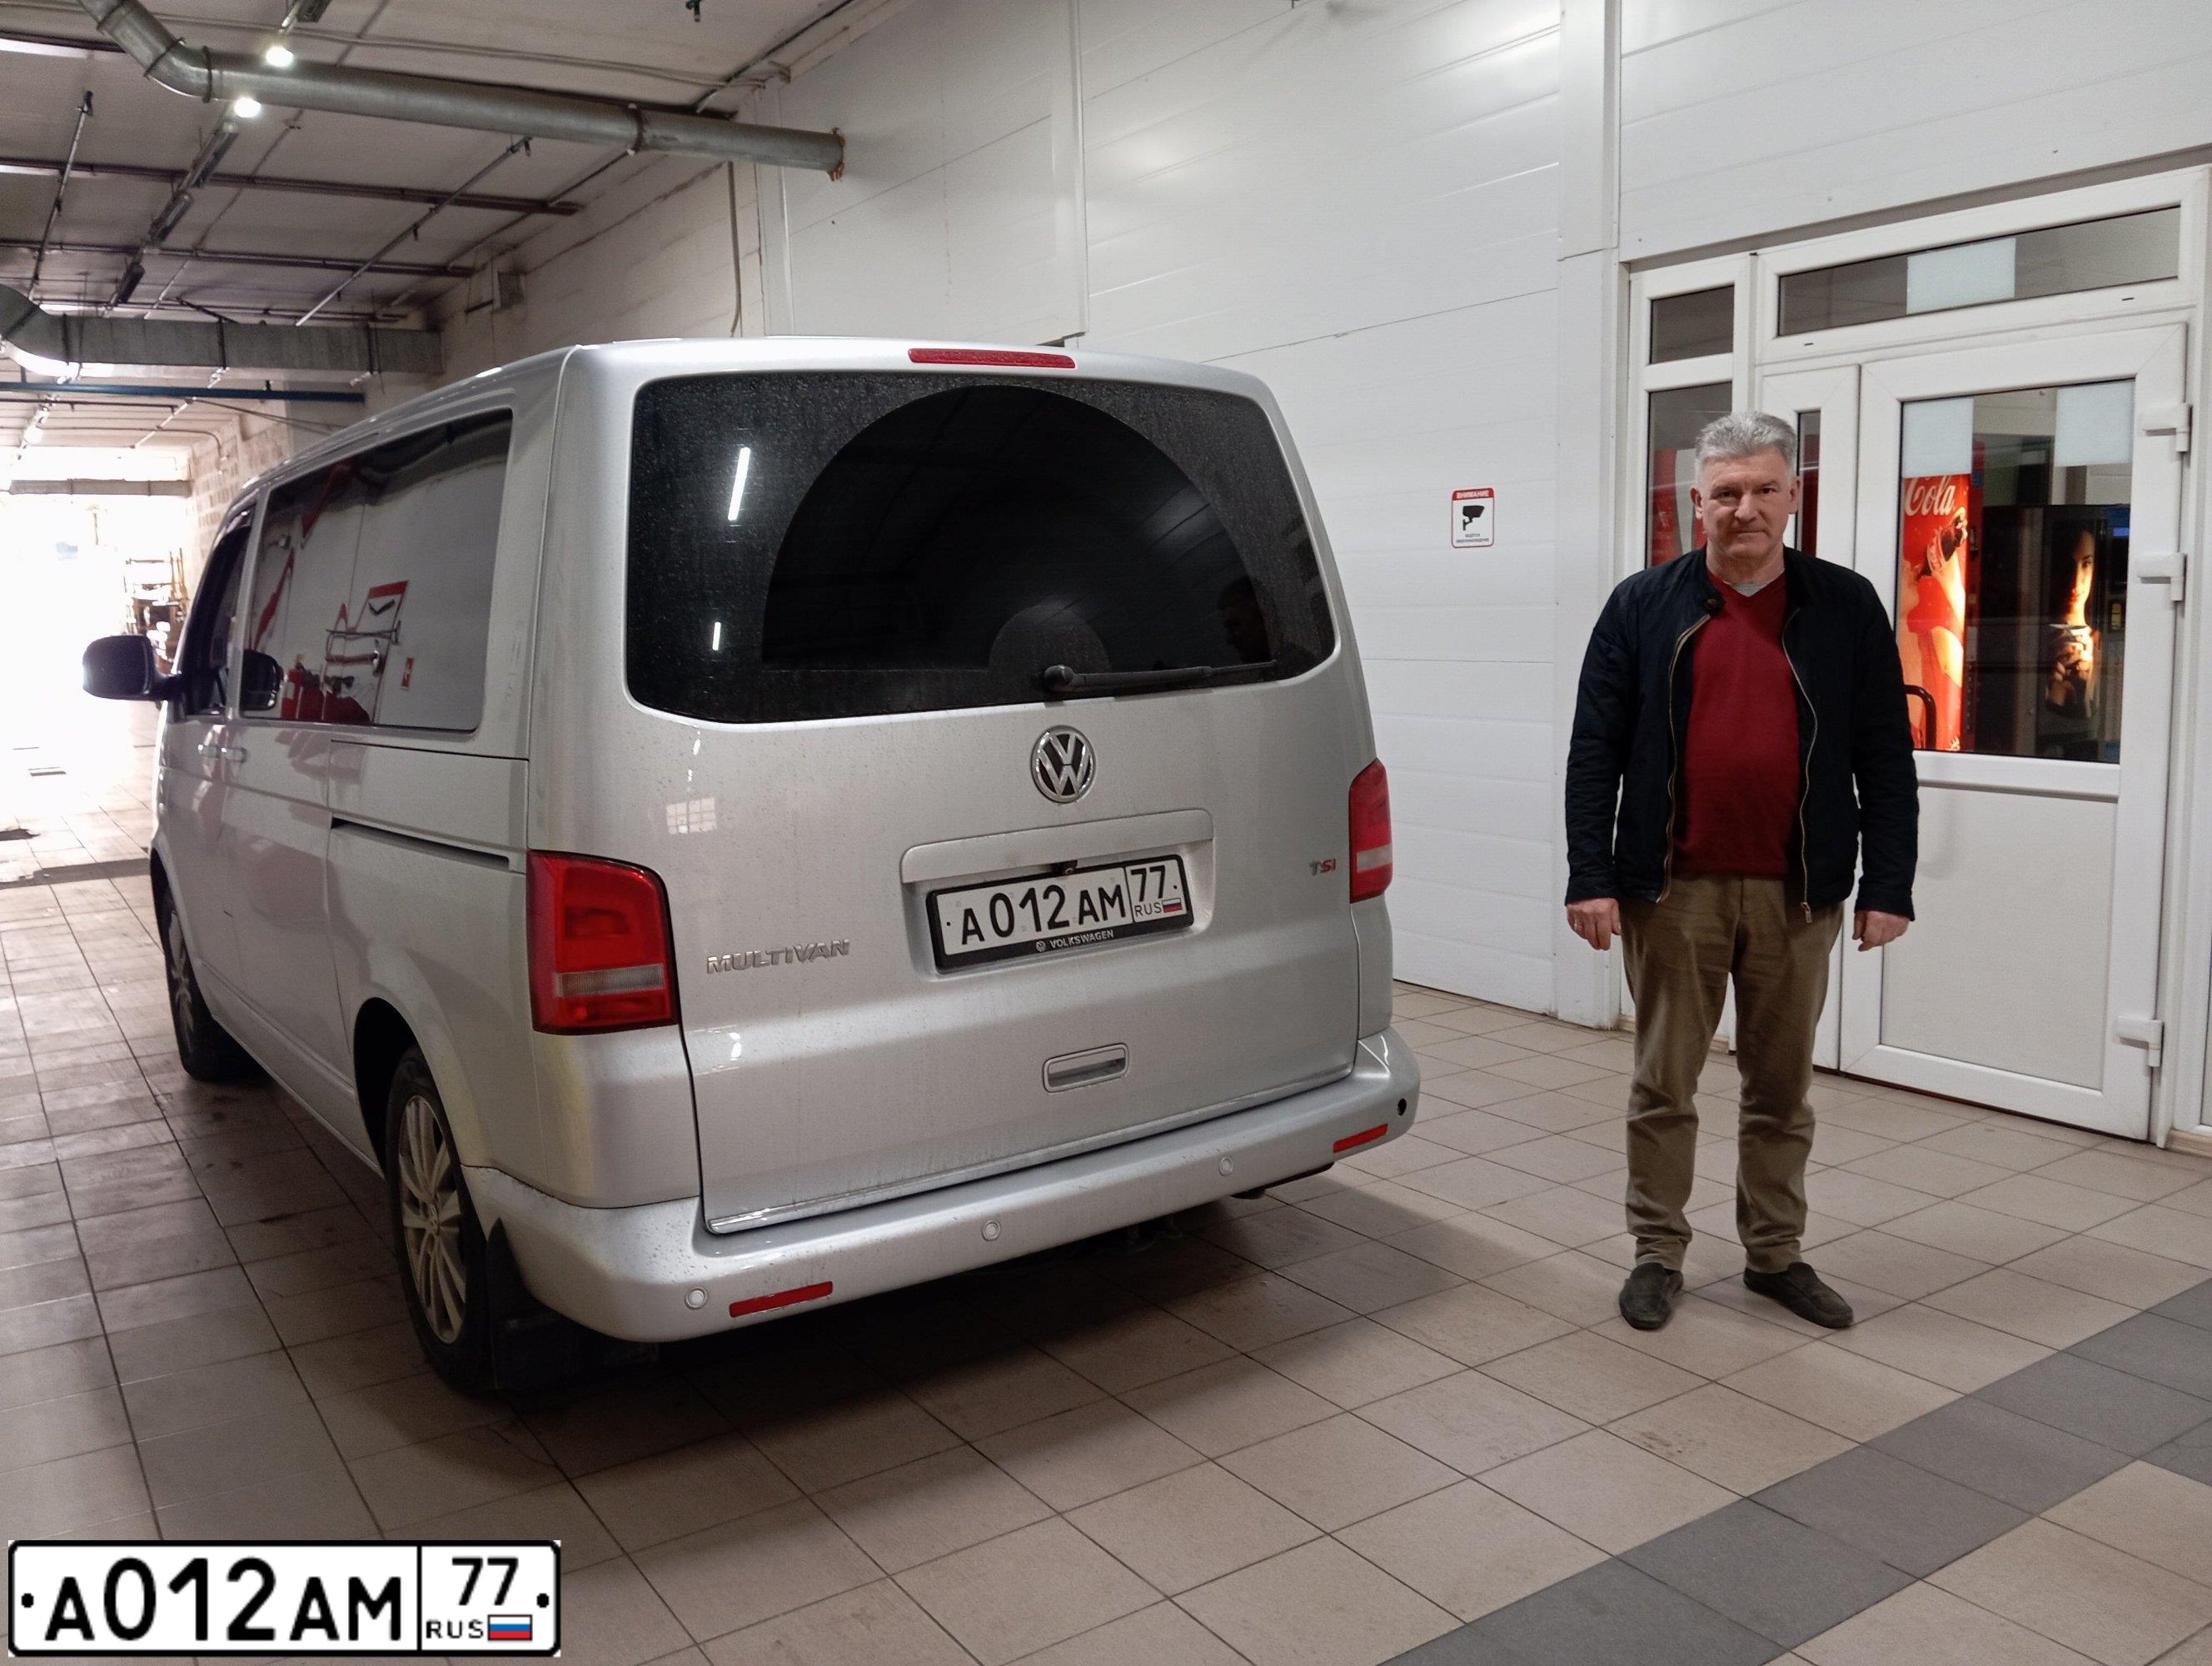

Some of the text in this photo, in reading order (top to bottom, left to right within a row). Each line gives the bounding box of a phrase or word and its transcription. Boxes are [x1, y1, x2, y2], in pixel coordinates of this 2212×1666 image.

[1309, 858, 1336, 876] TSI
[1130, 865, 1167, 902] 77
[1134, 901, 1162, 917] RUS
[1049, 929, 1114, 949] VOLKSWAGEN
[706, 939, 850, 974] MULTIVAN
